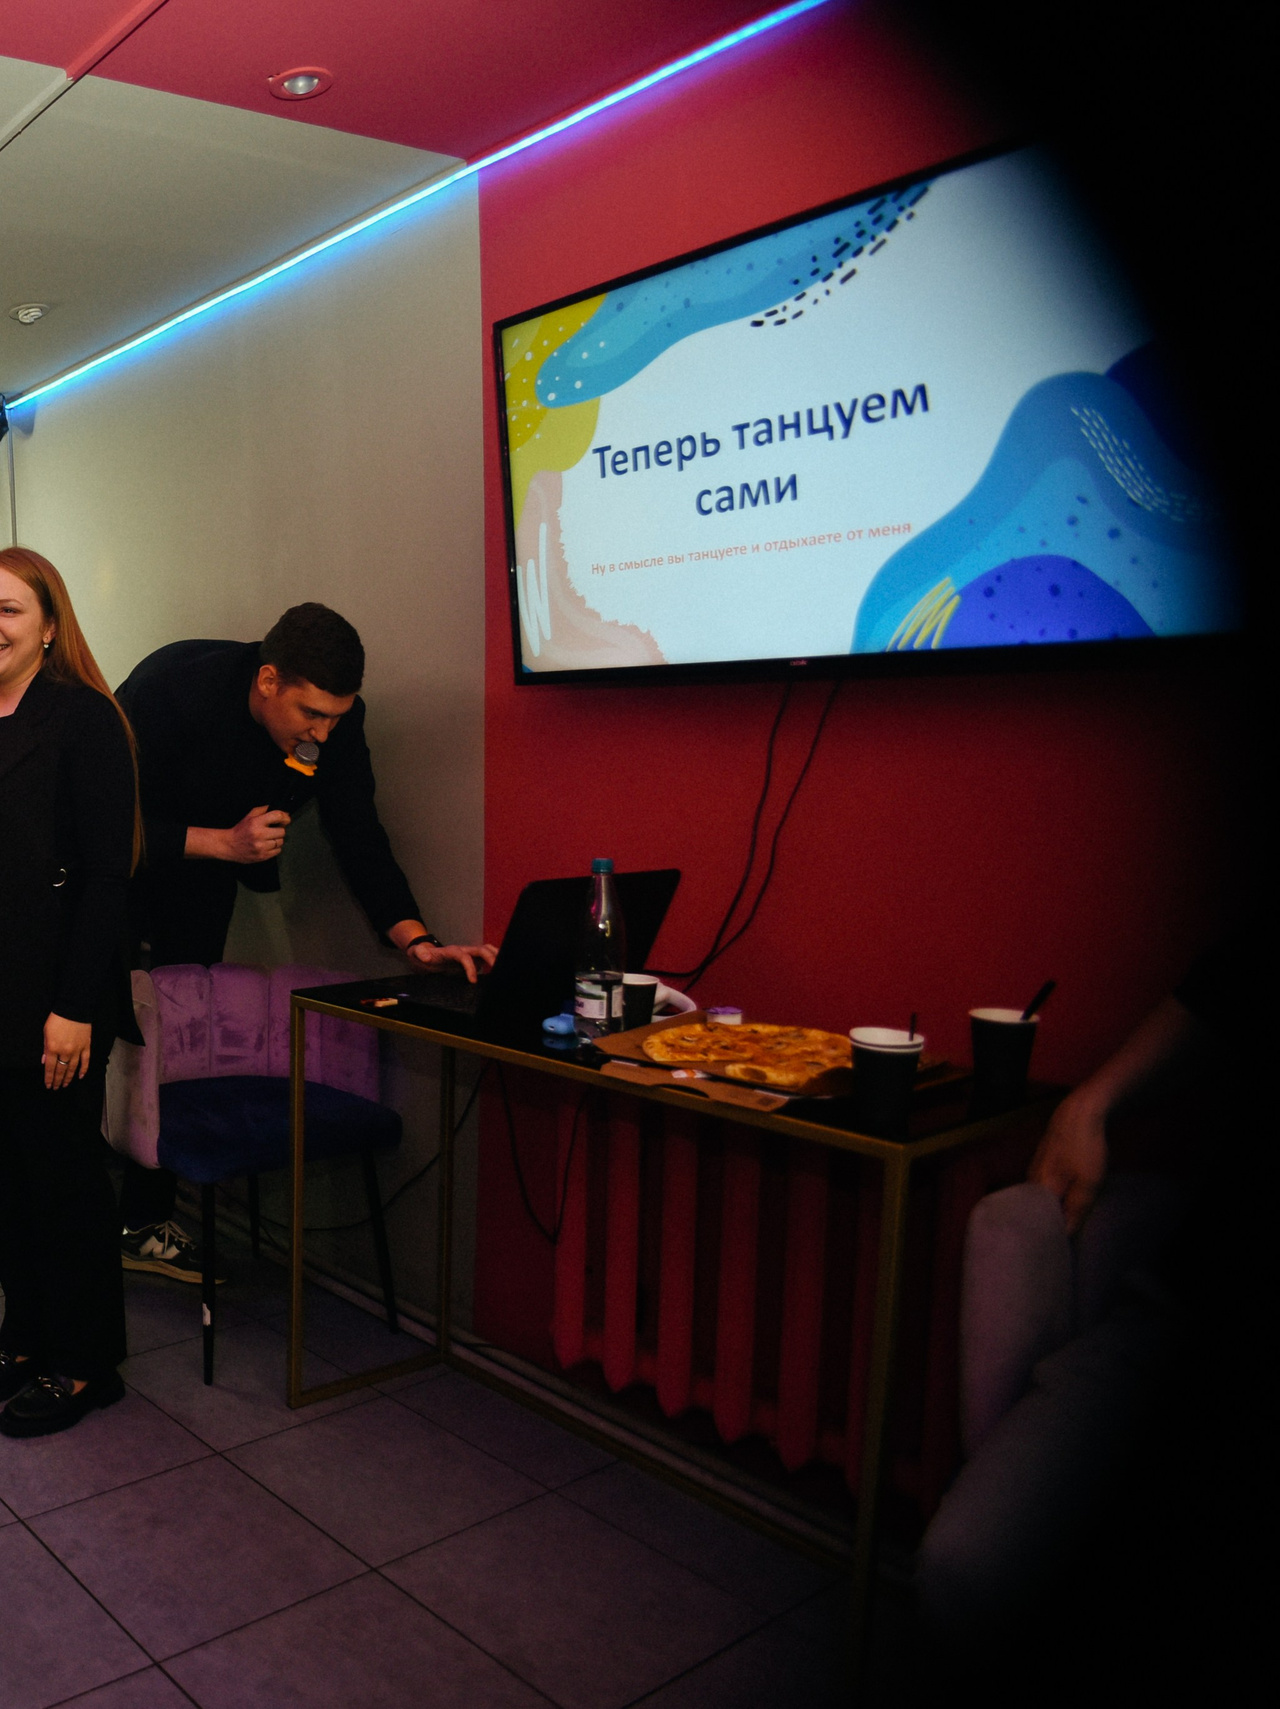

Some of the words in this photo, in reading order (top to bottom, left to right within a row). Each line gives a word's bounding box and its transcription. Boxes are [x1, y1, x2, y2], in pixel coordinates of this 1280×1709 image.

[592, 432, 721, 479] Теперь
[731, 383, 929, 450] танцуем
[696, 474, 797, 516] сами
[591, 563, 606, 576] Ну
[609, 563, 615, 572] в
[618, 556, 663, 571] смысле
[667, 554, 685, 564] вы
[688, 545, 747, 561] танцуете
[751, 543, 760, 553] и
[764, 532, 842, 552] отдыхаете
[846, 529, 863, 541] от
[868, 523, 912, 538] меня
